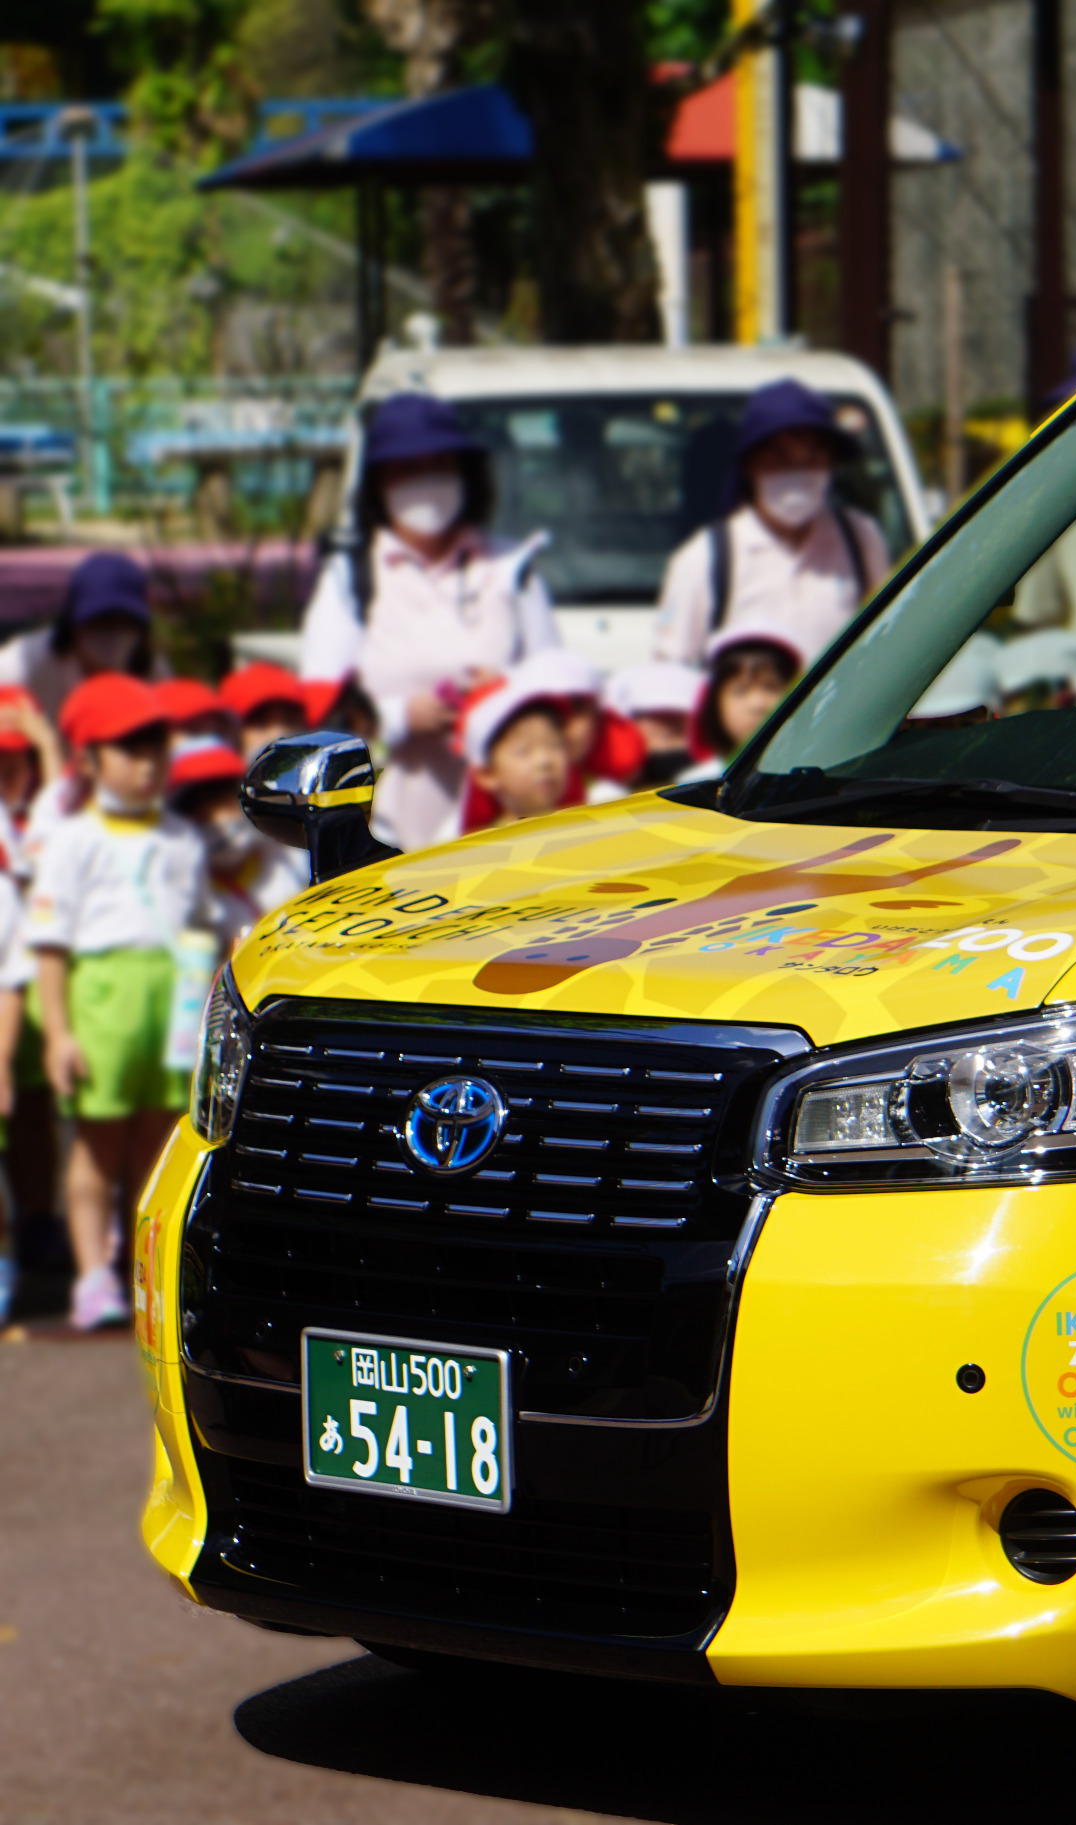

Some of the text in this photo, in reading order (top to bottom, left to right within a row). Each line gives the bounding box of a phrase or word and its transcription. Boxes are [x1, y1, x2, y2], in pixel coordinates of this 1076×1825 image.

[293, 885, 599, 923] WONDERFUL
[259, 910, 514, 941] SETOUCHI
[731, 924, 1075, 961] IKEDA ZOO
[318, 1398, 499, 1495] あ 54-18
